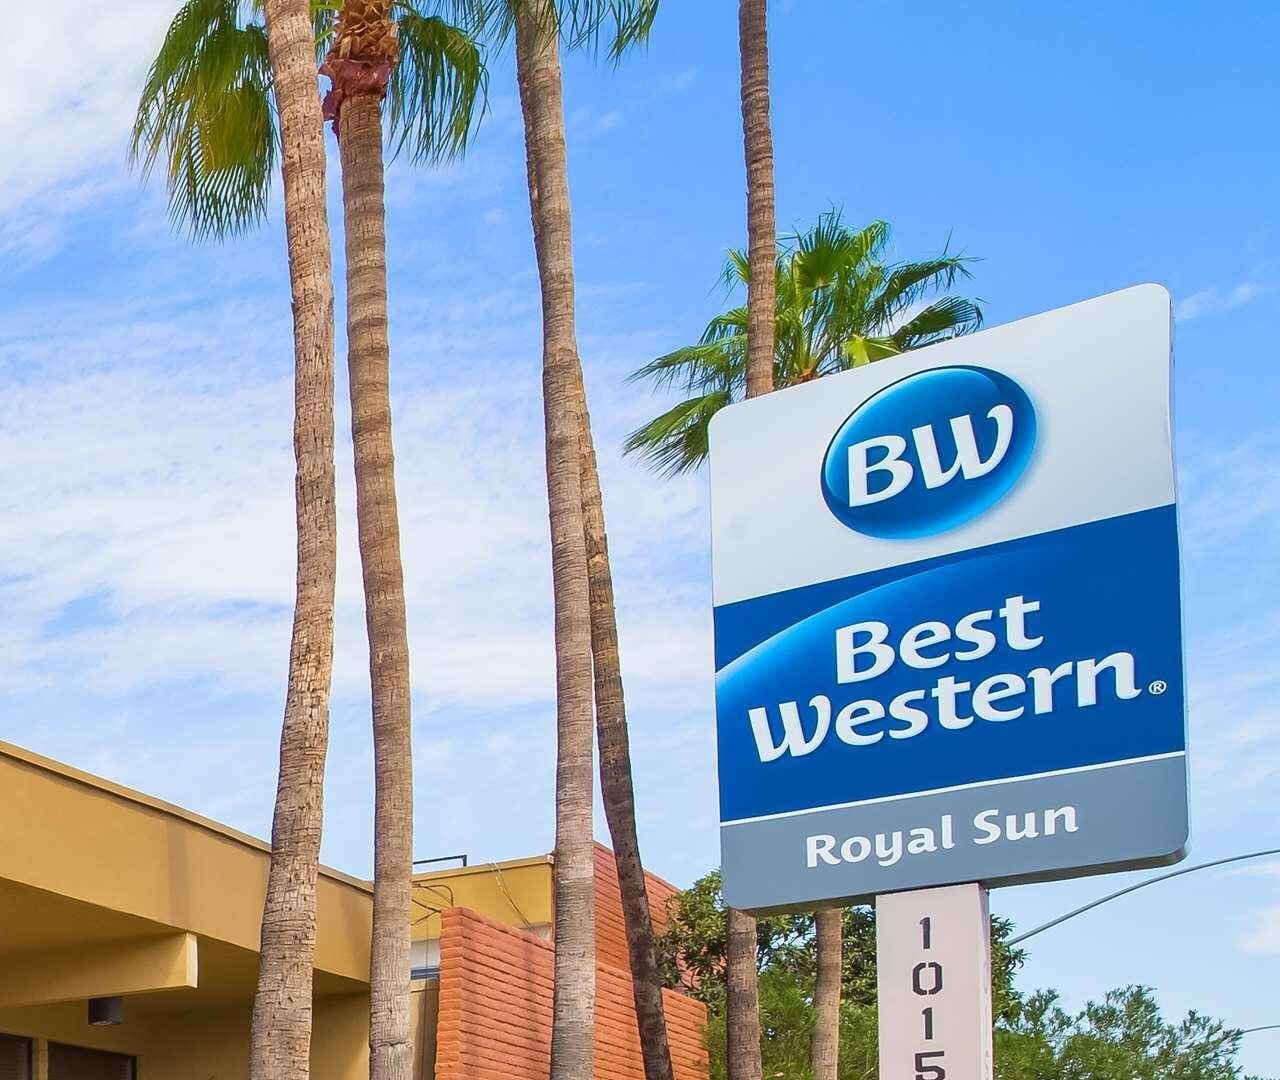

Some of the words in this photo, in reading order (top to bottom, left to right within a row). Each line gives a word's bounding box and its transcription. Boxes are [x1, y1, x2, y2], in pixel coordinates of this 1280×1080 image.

[847, 404, 1014, 508] BW
[835, 594, 1044, 685] Best
[806, 815, 954, 869] Royal
[973, 805, 1079, 845] Sun
